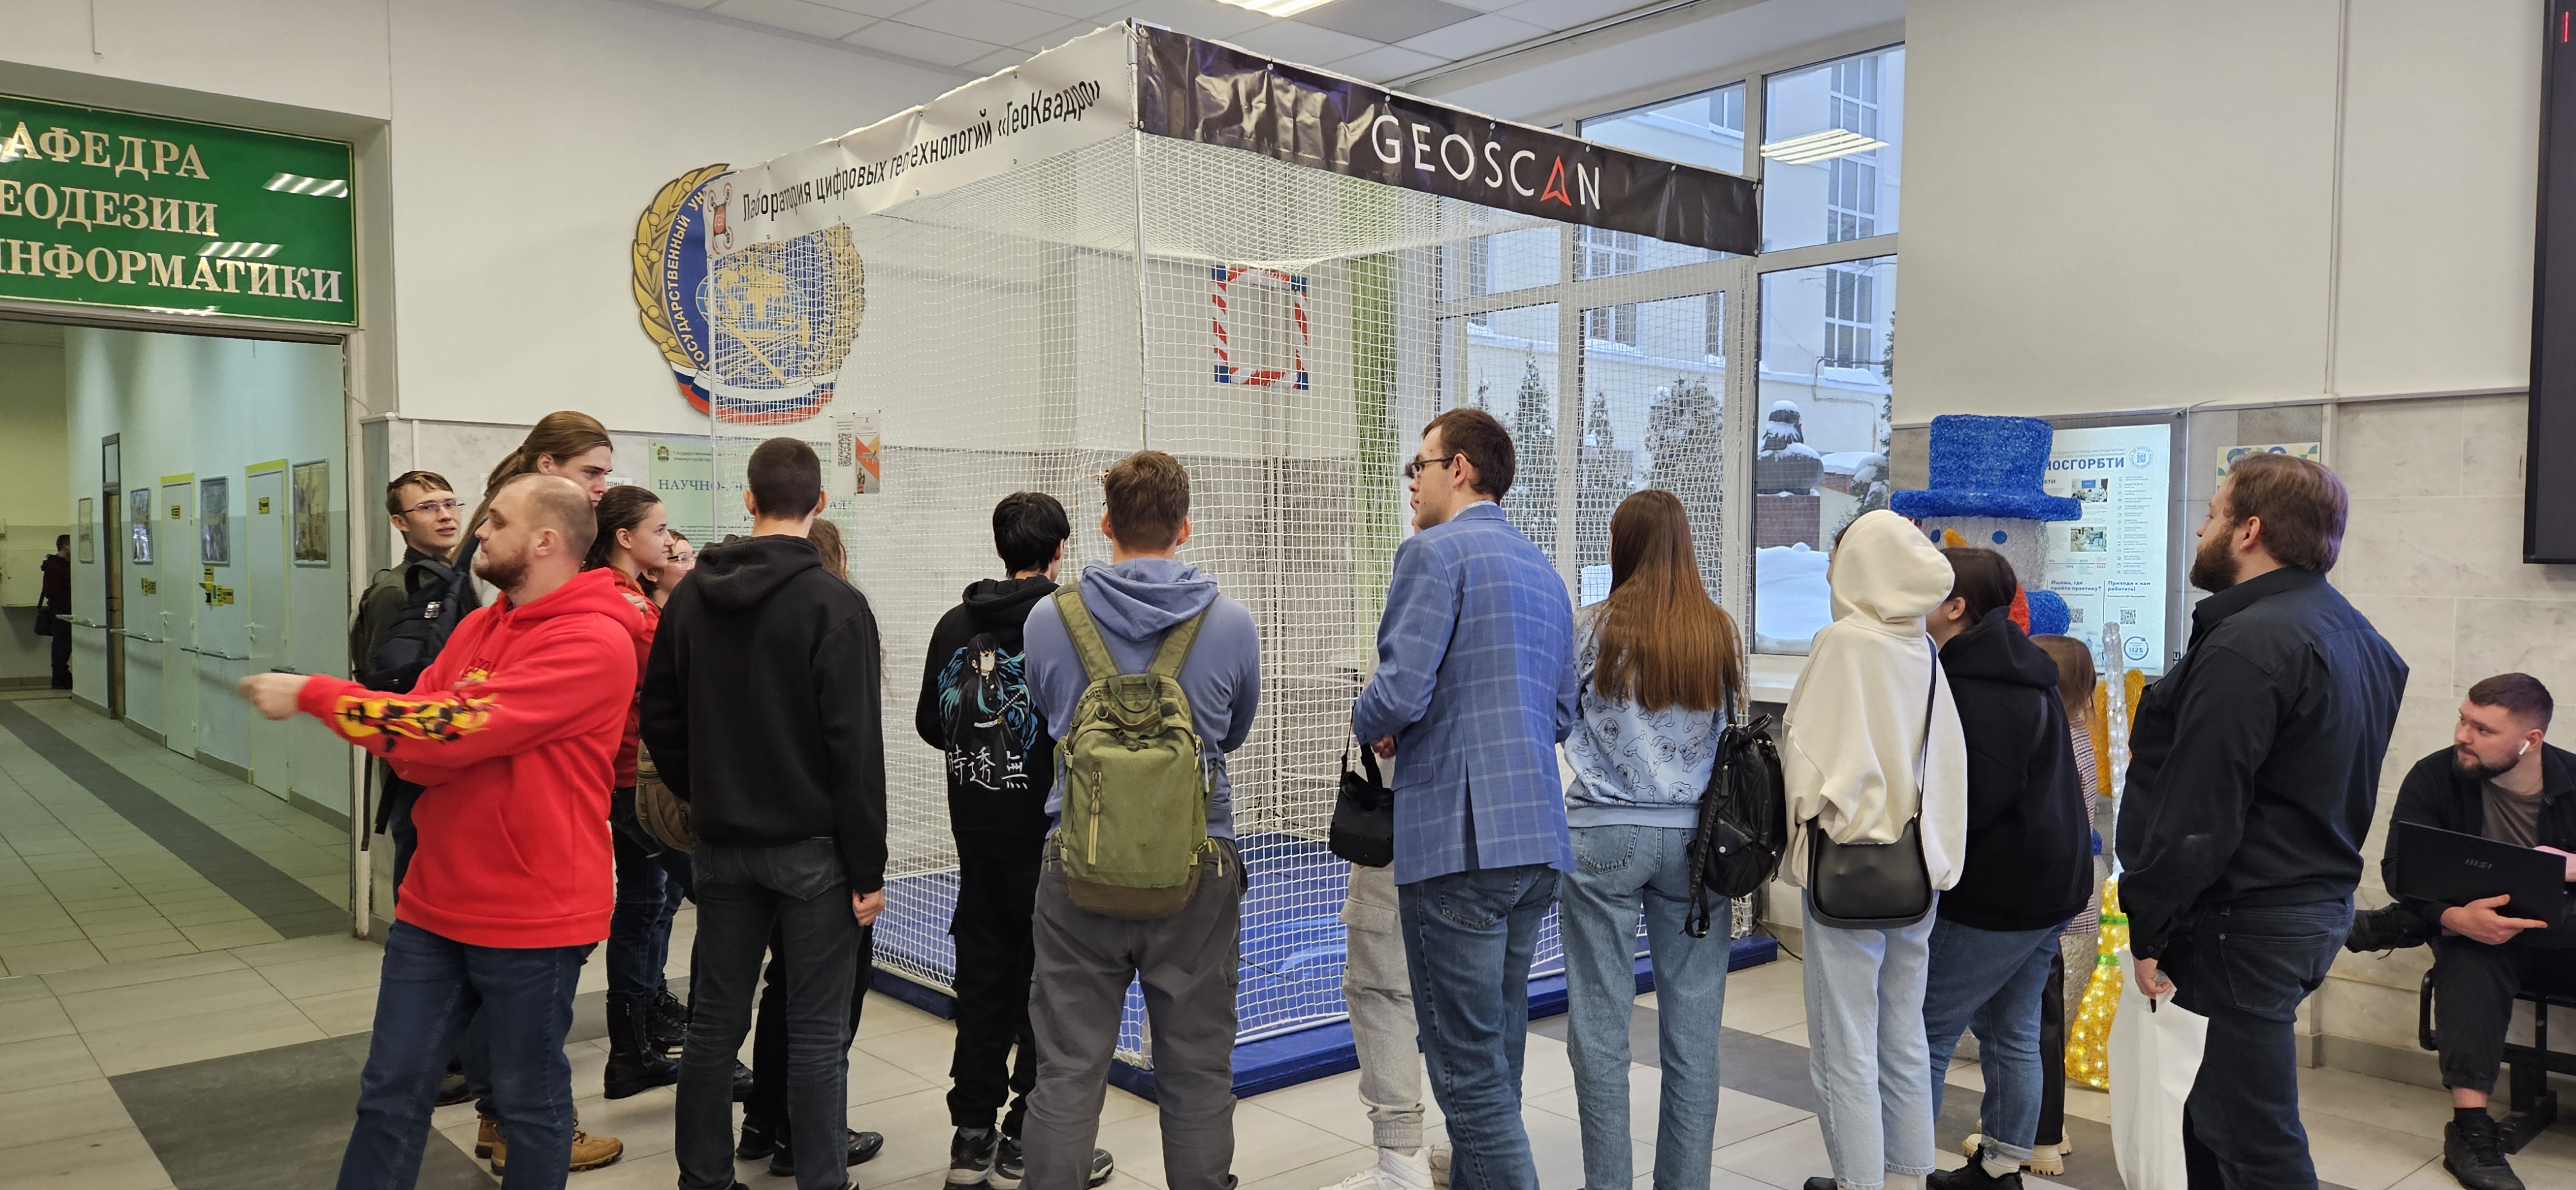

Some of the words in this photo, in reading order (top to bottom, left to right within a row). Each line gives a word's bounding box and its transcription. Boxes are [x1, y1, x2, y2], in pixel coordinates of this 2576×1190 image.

[0, 120, 210, 181] АФЕДРА
[743, 181, 811, 222] Лаборатория
[816, 160, 887, 204] цифровых
[889, 108, 992, 179] геоехнологий
[998, 80, 1101, 137] «ГеоКвадро»
[1372, 115, 1601, 210] GEOSCAN
[0, 178, 219, 237] ЕОДЕЗИИ
[0, 238, 343, 303] НФОРМАТИКИ
[667, 214, 711, 370] ГОСУДАРСТВЕННЫЙ
